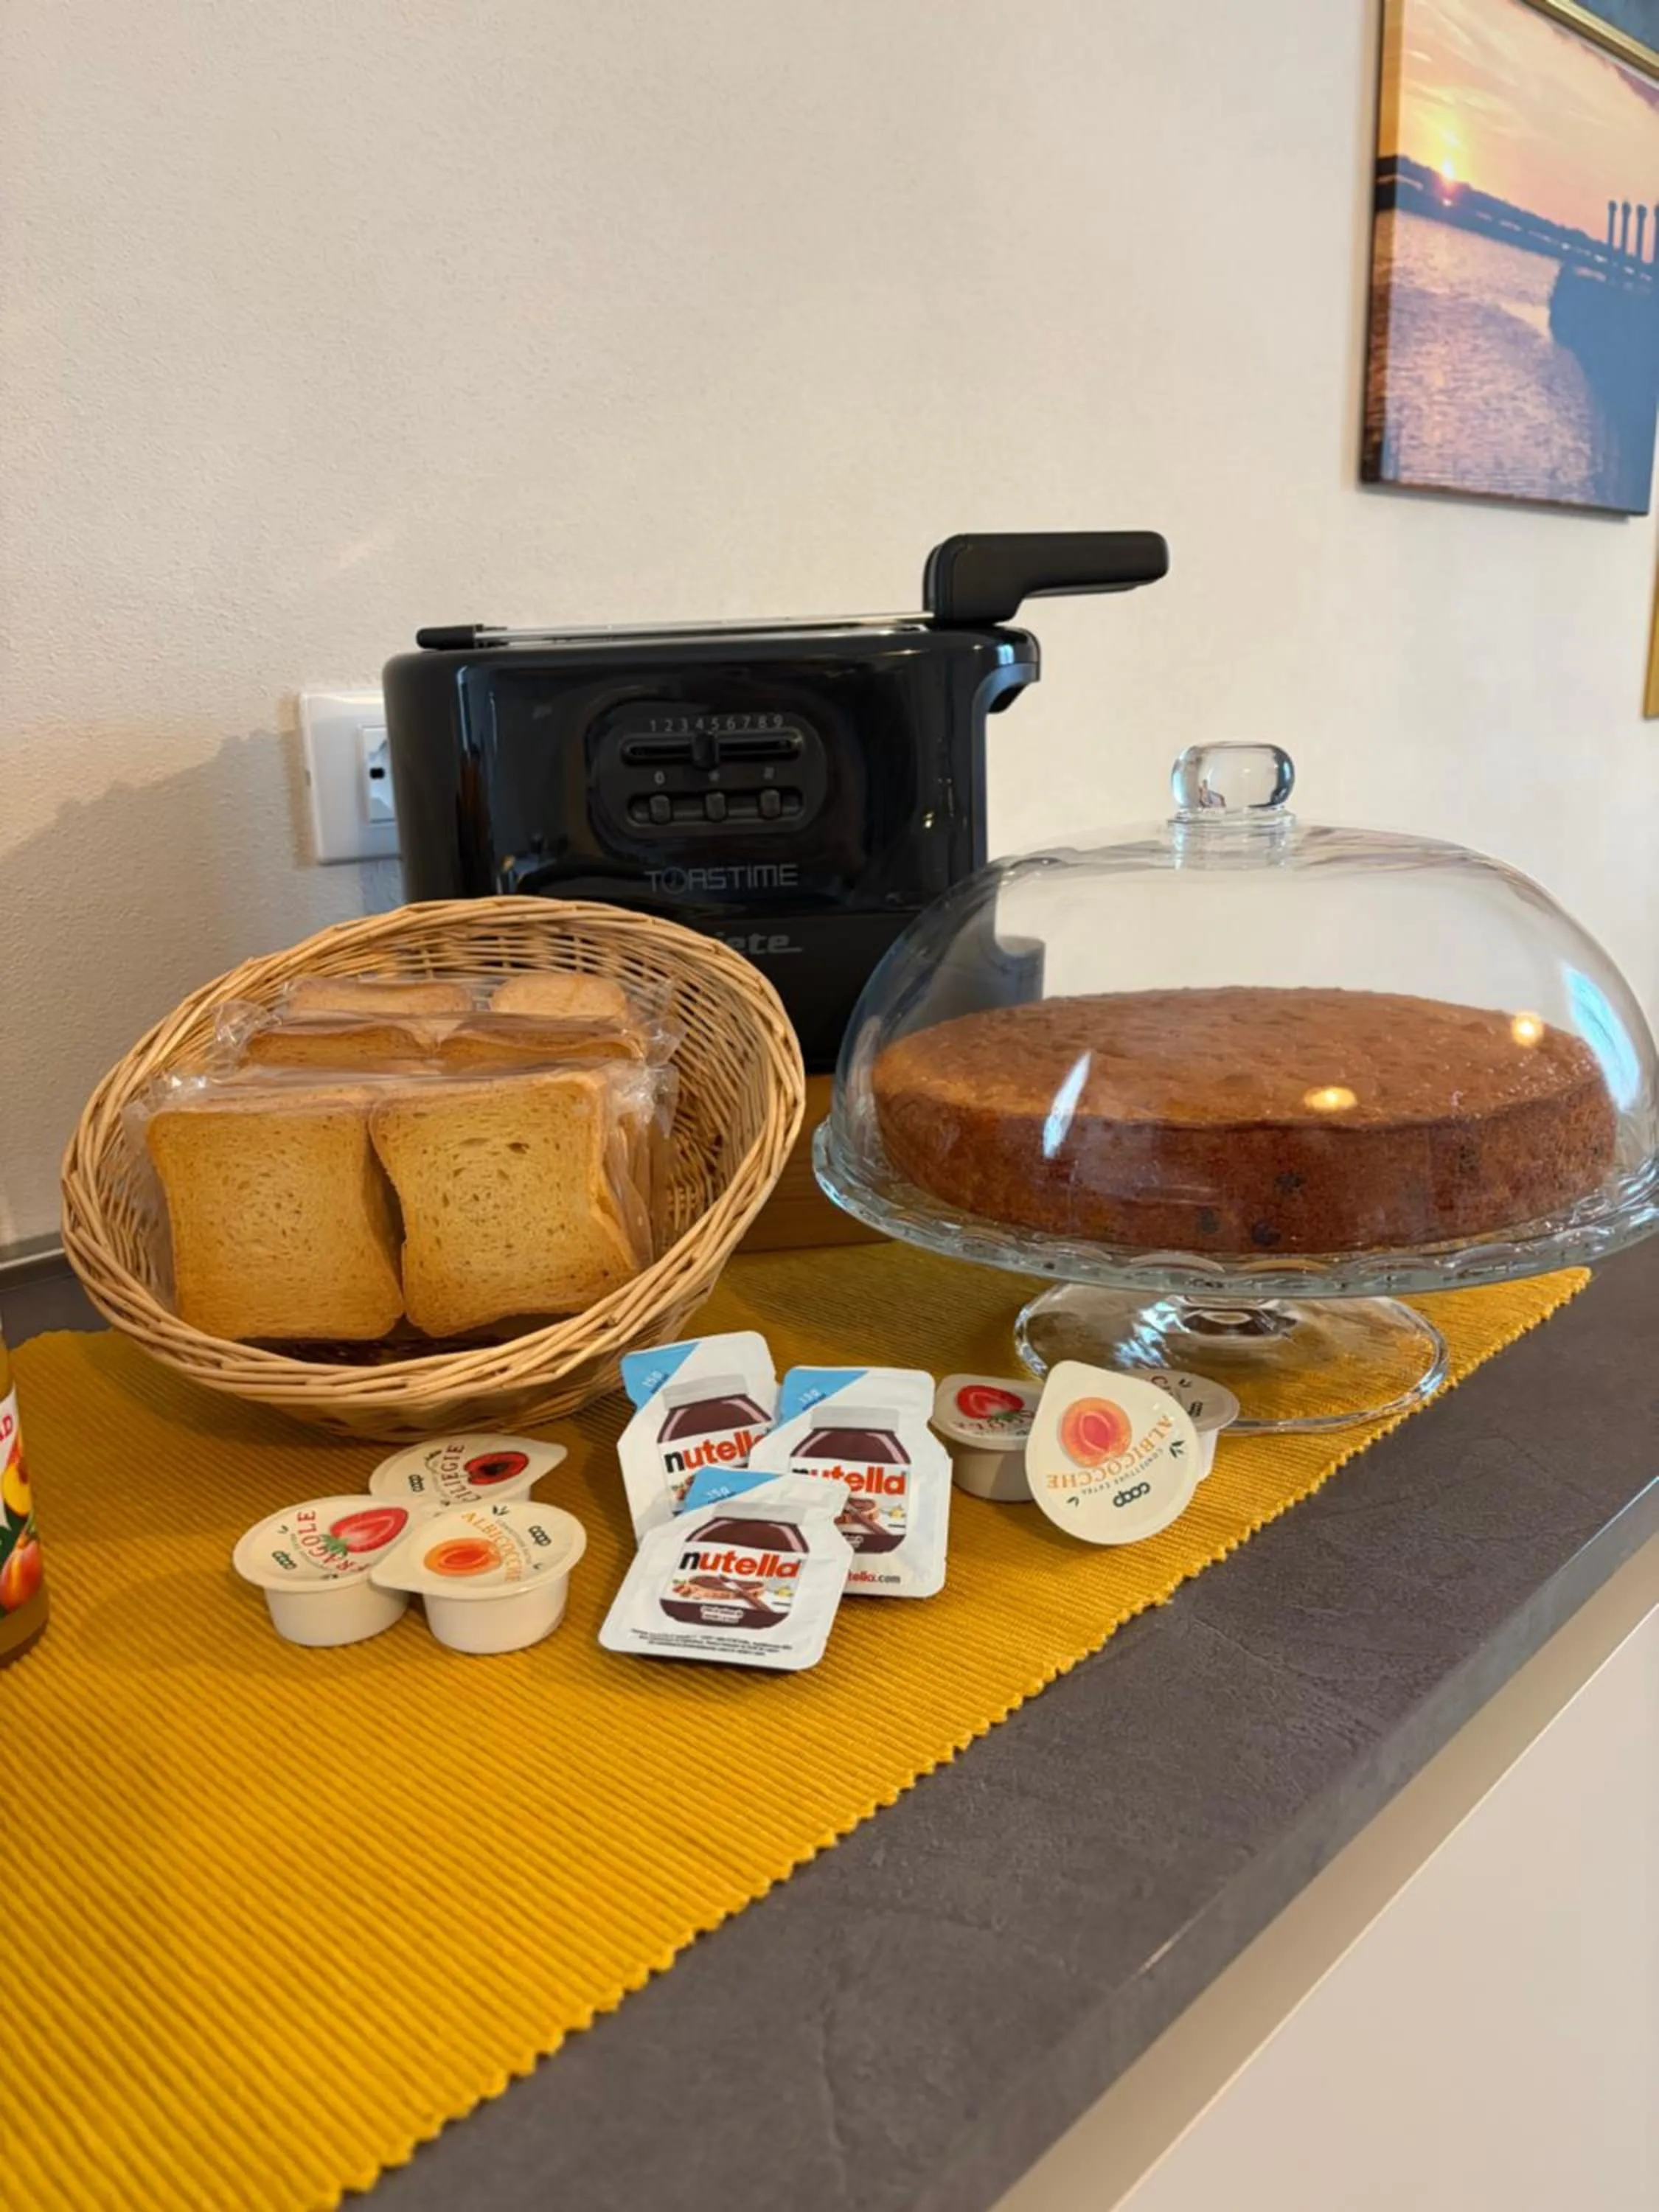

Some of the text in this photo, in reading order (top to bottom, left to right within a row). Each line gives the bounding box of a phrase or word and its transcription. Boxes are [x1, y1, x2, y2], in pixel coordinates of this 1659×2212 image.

[650, 714, 784, 731] 1 2 3 4 5 6 7 8 9
[644, 864, 799, 894] TOASTIME
[1047, 1414, 1172, 1489] ALBICOCCHE
[1113, 1481, 1151, 1508] coop
[678, 1551, 801, 1578] nutella
